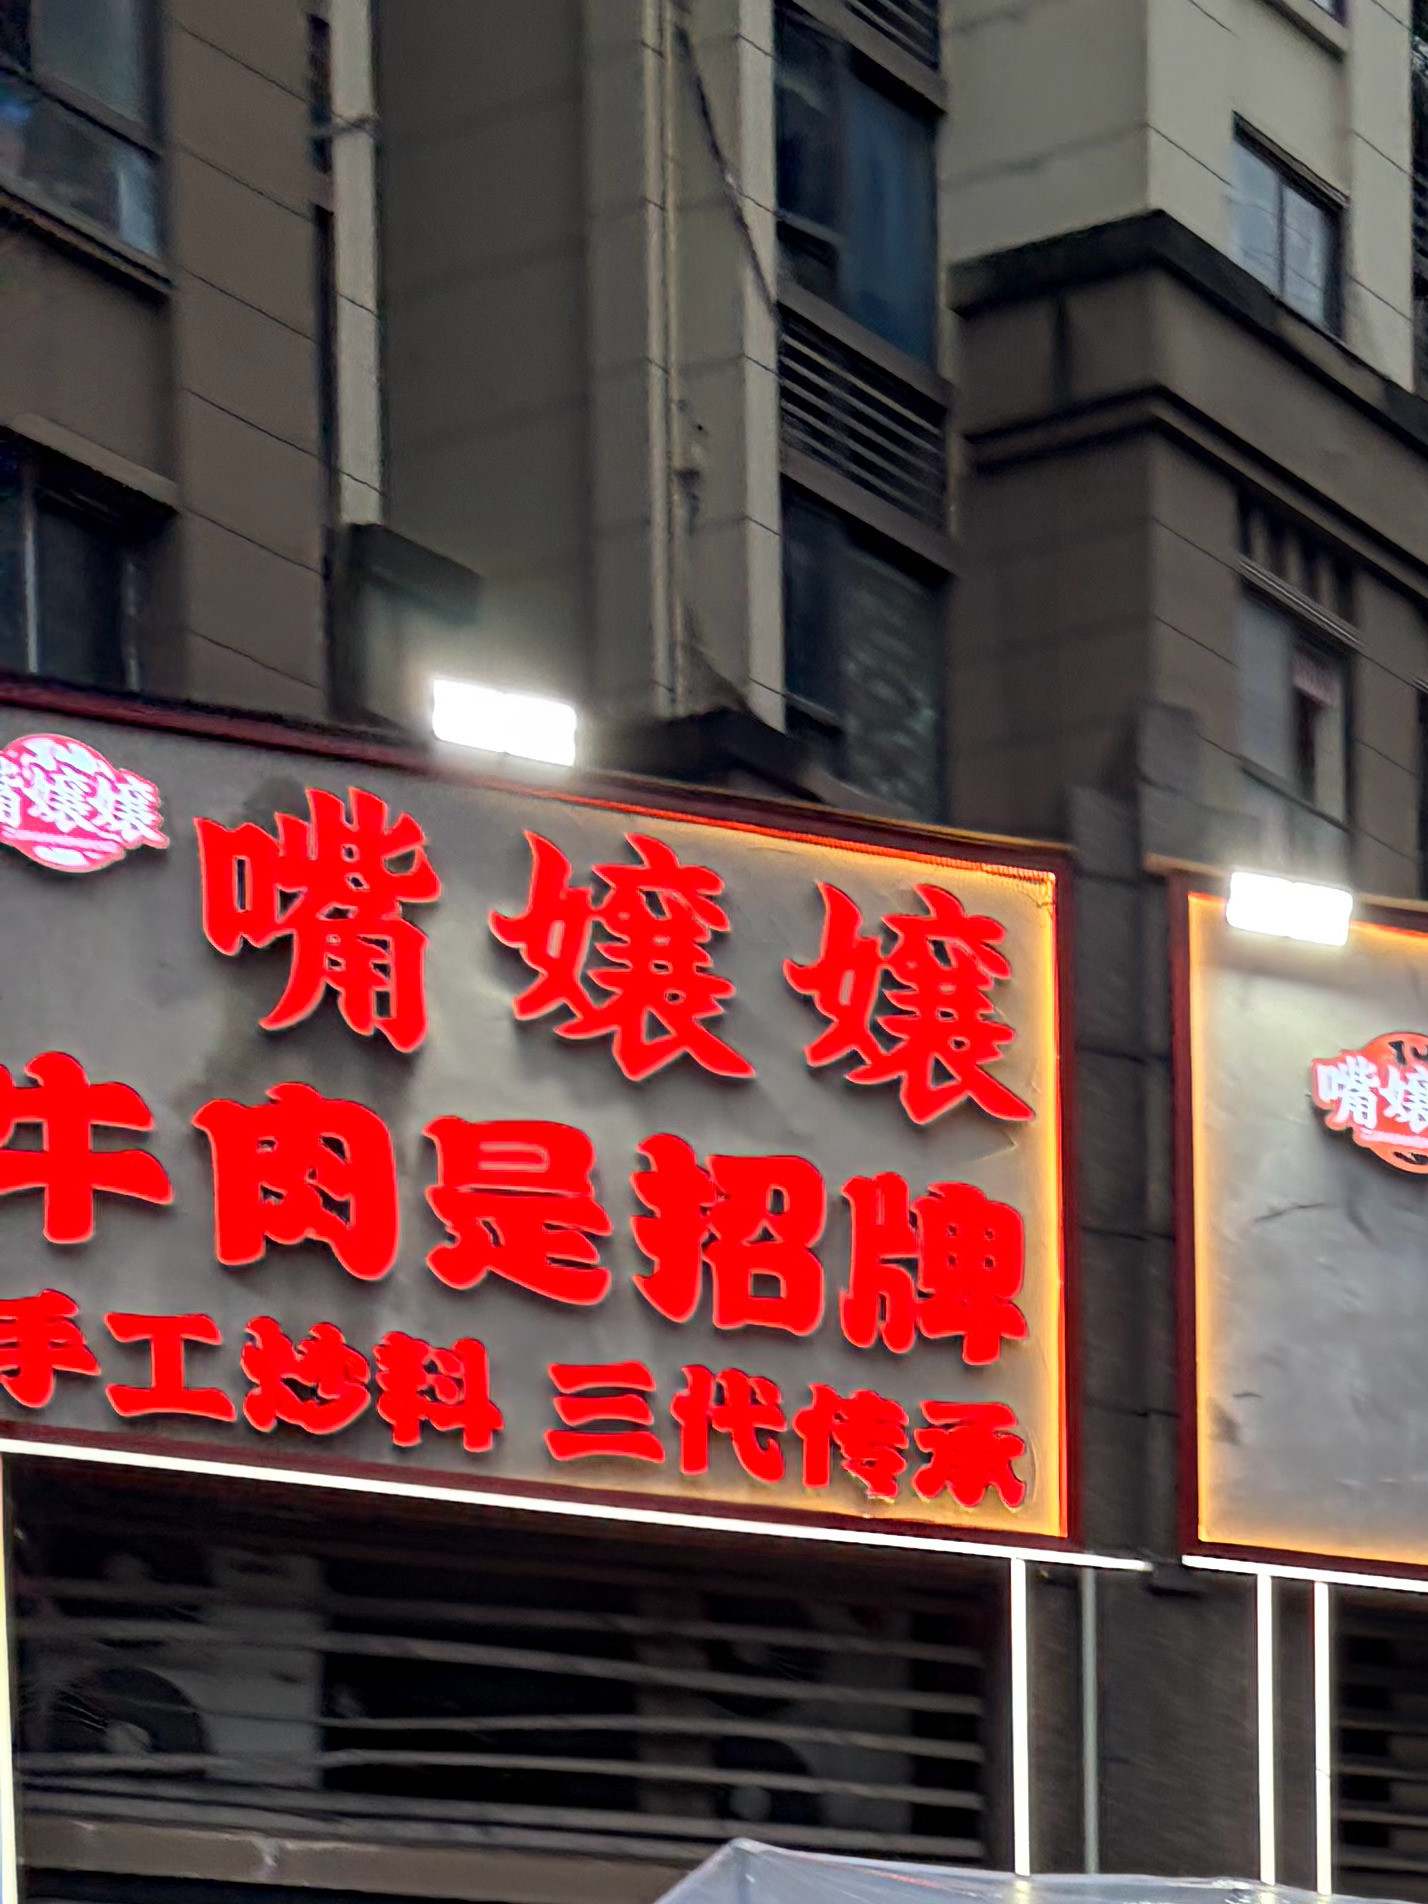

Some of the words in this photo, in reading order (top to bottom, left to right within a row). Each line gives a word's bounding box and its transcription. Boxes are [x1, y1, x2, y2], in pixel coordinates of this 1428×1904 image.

[0, 1051, 1030, 1365] 牛肉是招牌
[0, 1289, 504, 1450] 手工炒料
[545, 1360, 1026, 1510] 三代传承
